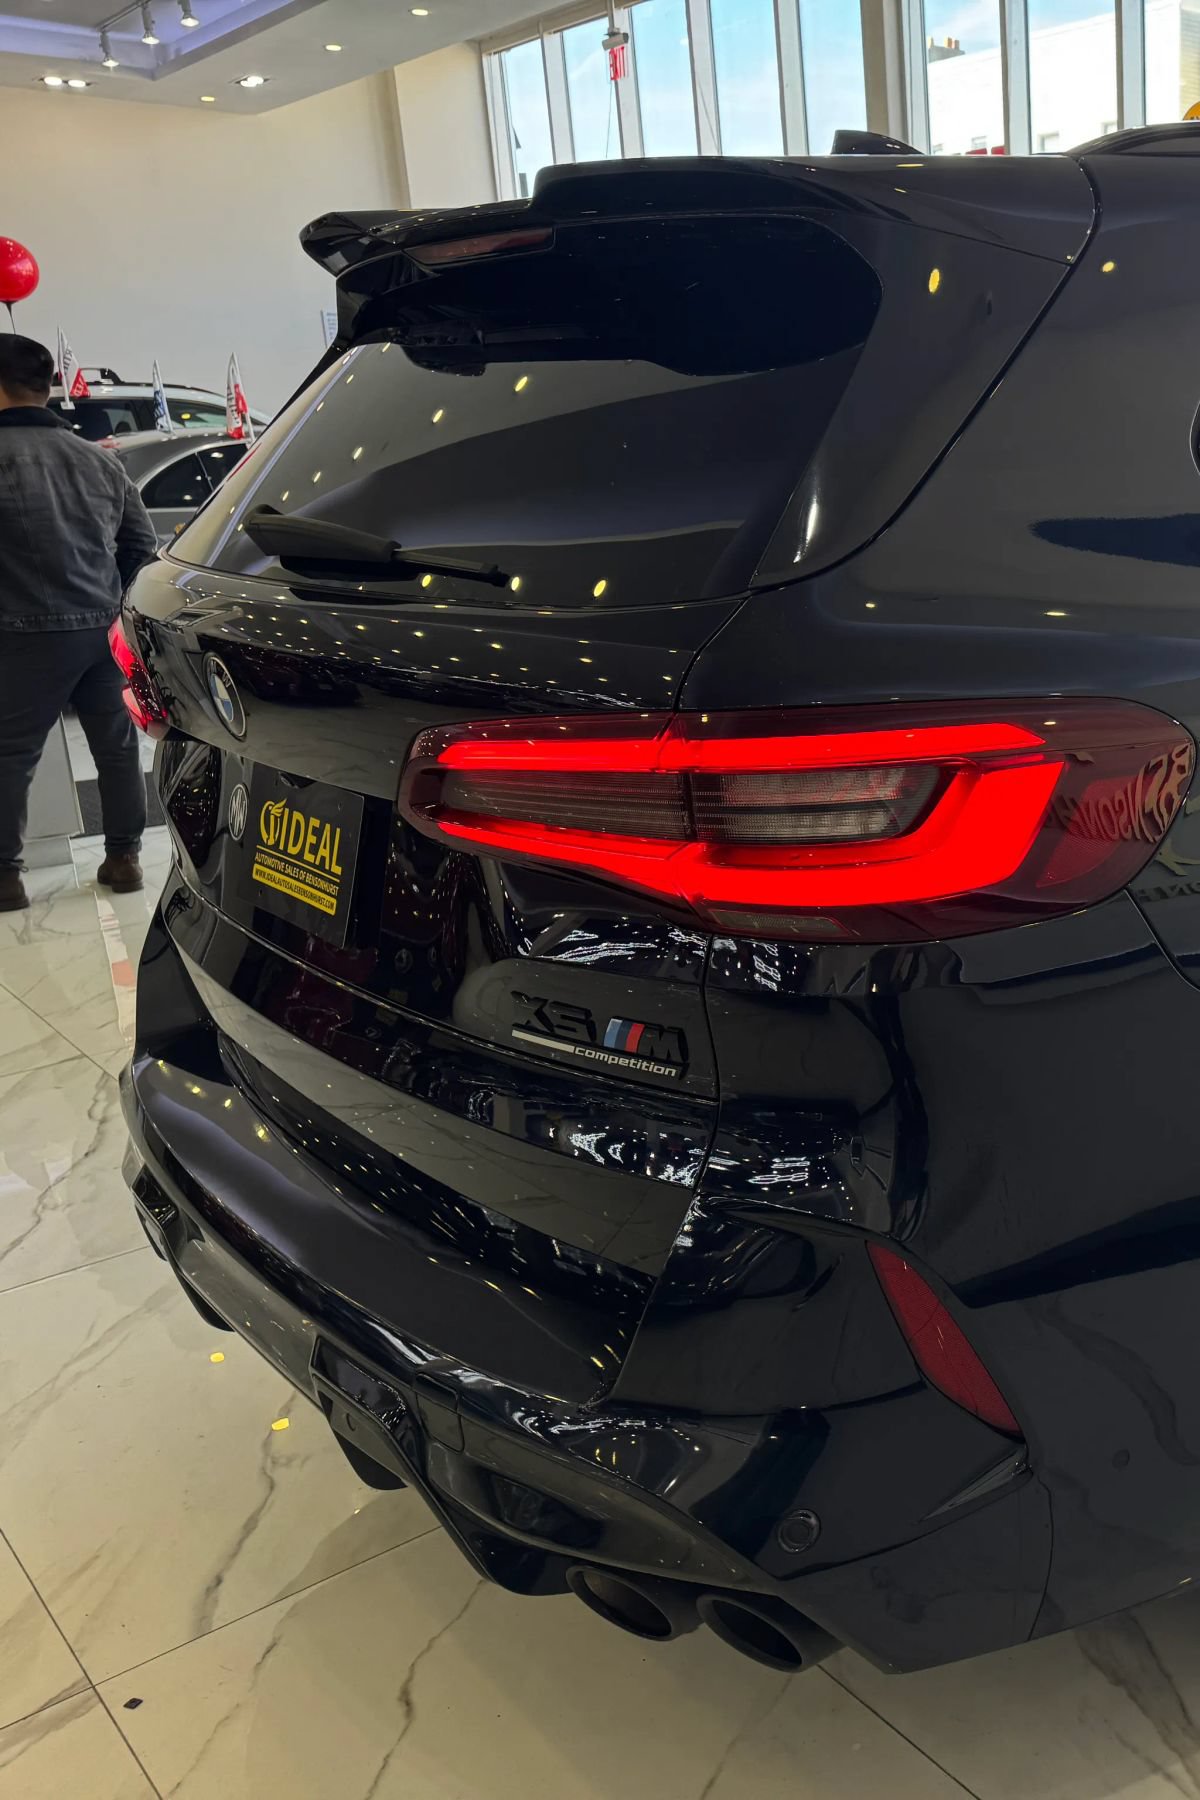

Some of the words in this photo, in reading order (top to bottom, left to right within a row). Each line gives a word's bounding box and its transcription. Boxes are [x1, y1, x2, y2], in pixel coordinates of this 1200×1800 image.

[279, 808, 342, 876] IDEAL
[255, 852, 285, 873] AUTOMOTIVE
[285, 863, 299, 878] SALES
[299, 869, 307, 881] OF
[306, 872, 339, 896] BENSONHURST
[574, 1046, 678, 1077] competition
